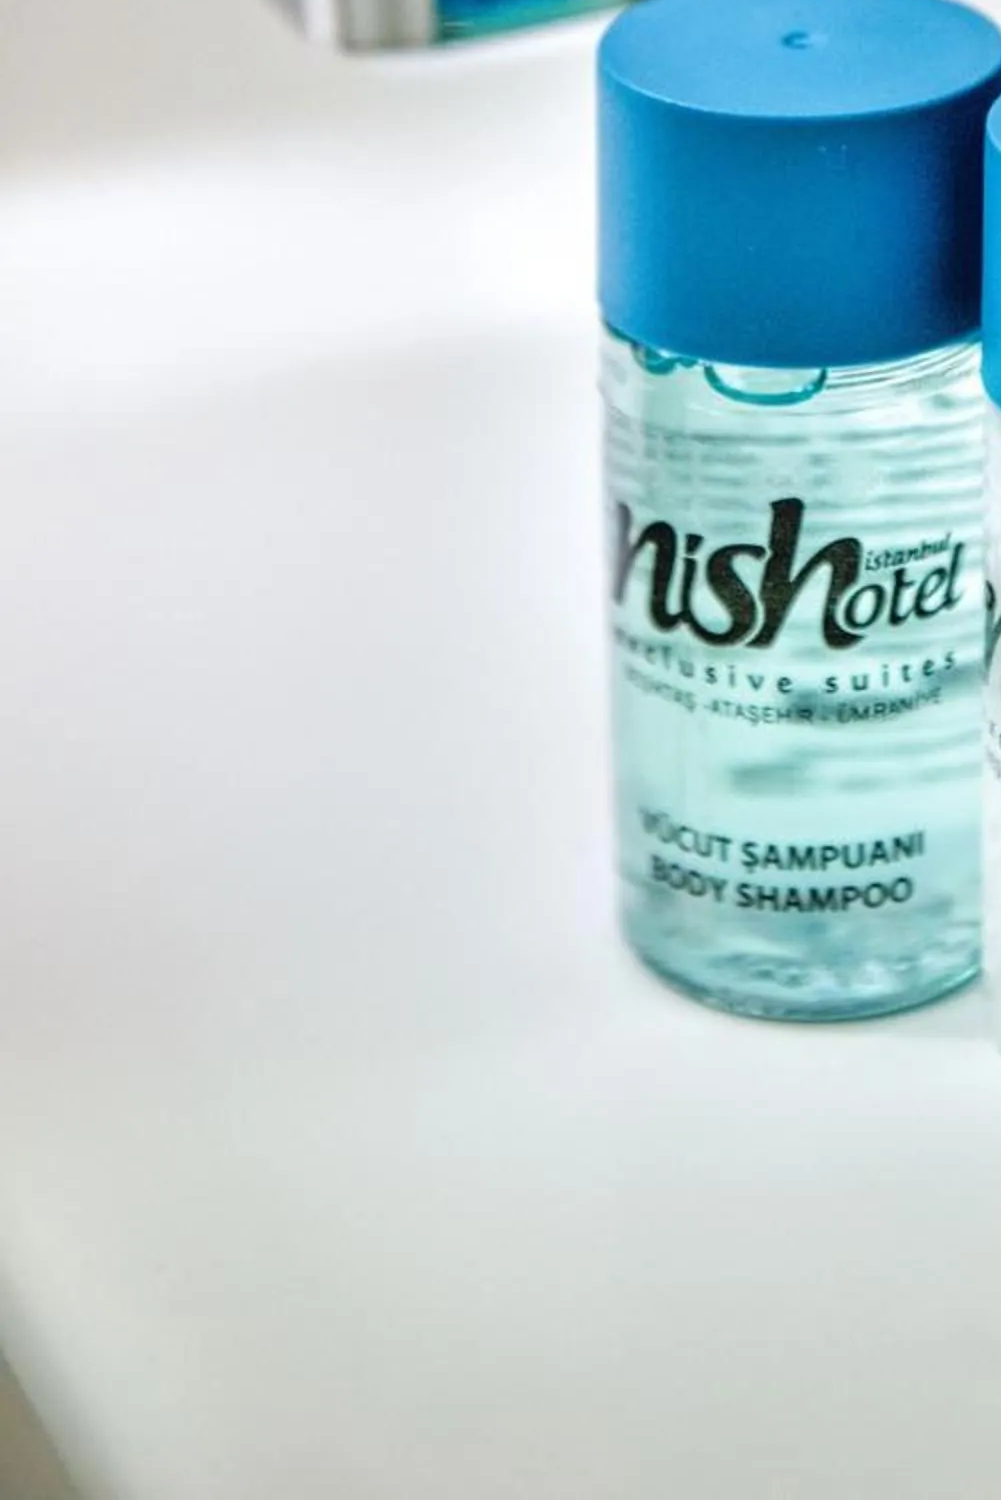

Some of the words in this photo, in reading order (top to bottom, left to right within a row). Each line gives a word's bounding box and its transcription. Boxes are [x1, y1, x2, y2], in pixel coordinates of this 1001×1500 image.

[825, 651, 956, 693] suites
[651, 853, 729, 902] BODY
[736, 877, 914, 913] SHAMPOO
